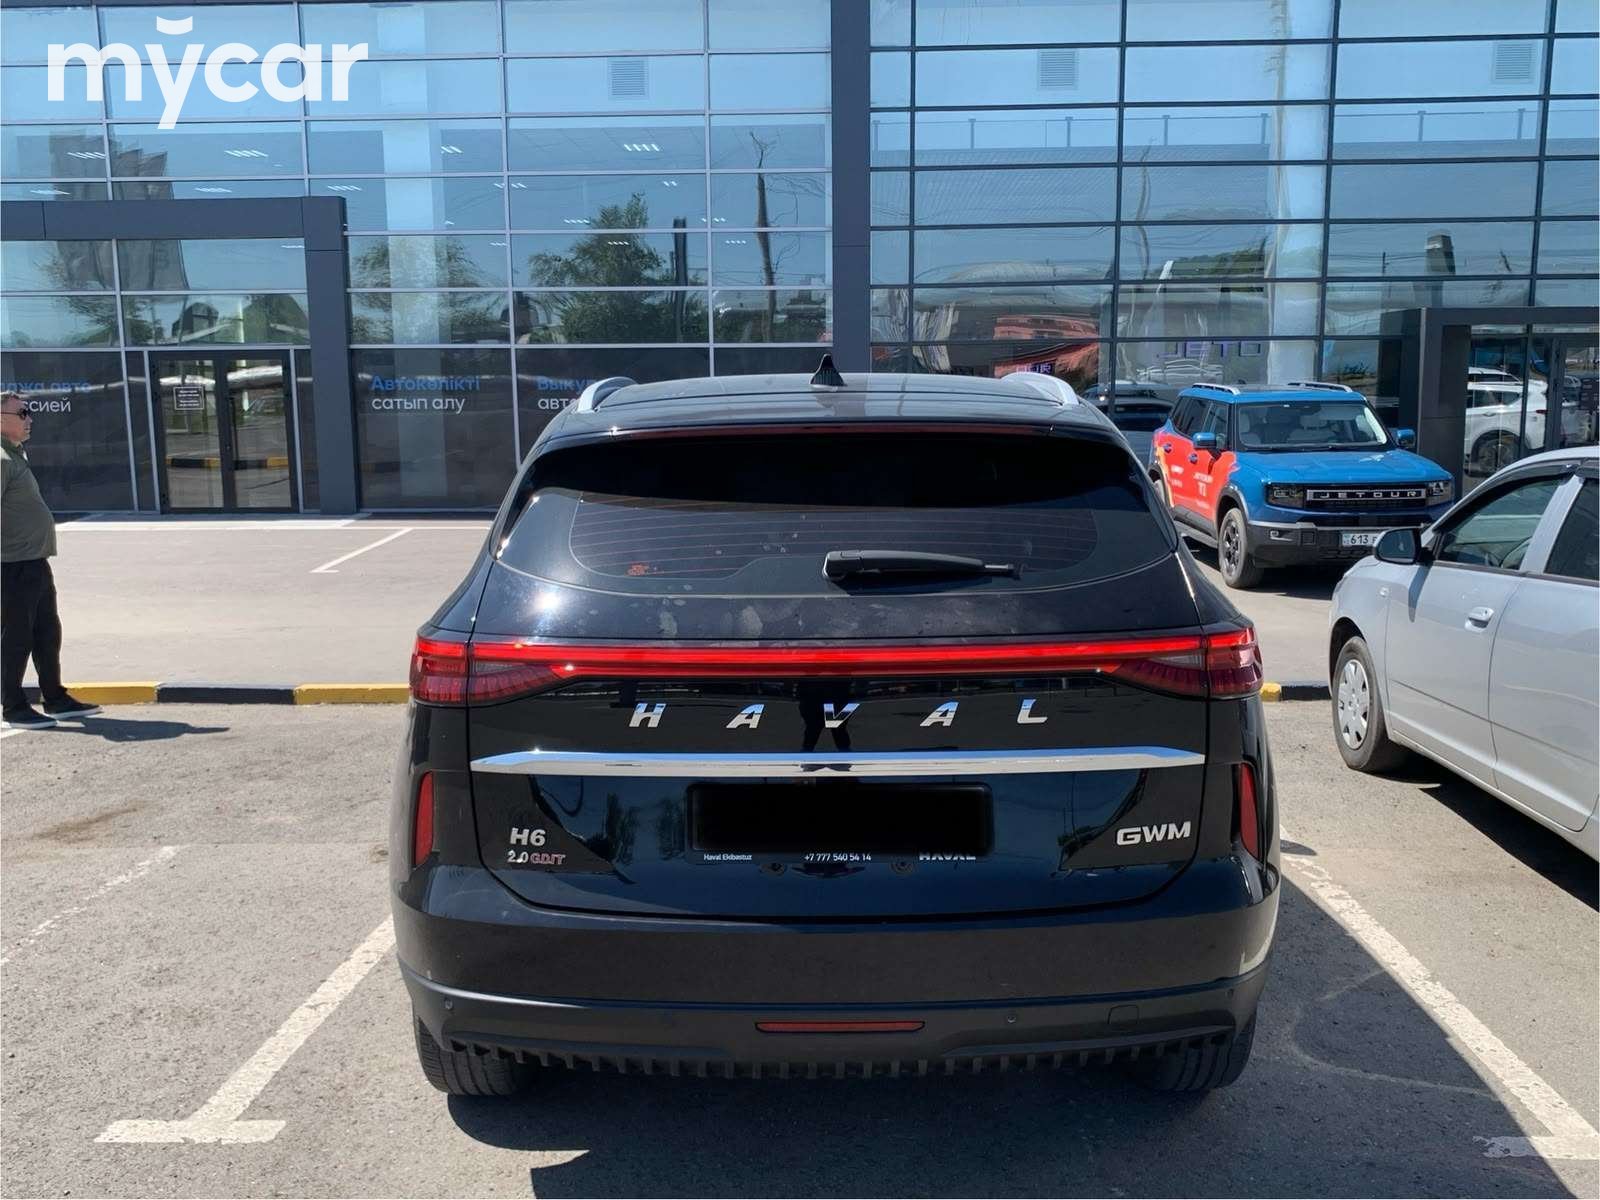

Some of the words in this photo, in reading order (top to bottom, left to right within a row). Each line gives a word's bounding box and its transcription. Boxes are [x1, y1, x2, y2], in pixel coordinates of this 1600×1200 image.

[372, 398, 428, 410] сатып
[432, 398, 465, 415] алу
[1320, 490, 1417, 499] JETOUR
[1350, 534, 1369, 545] 613
[629, 699, 1049, 729] HAVAL
[510, 827, 546, 847] H6
[1116, 820, 1192, 846] GWM
[804, 852, 814, 862] +7
[816, 852, 830, 862] 777
[832, 852, 848, 862] 540
[849, 852, 860, 862] 54
[862, 852, 872, 862] 14
